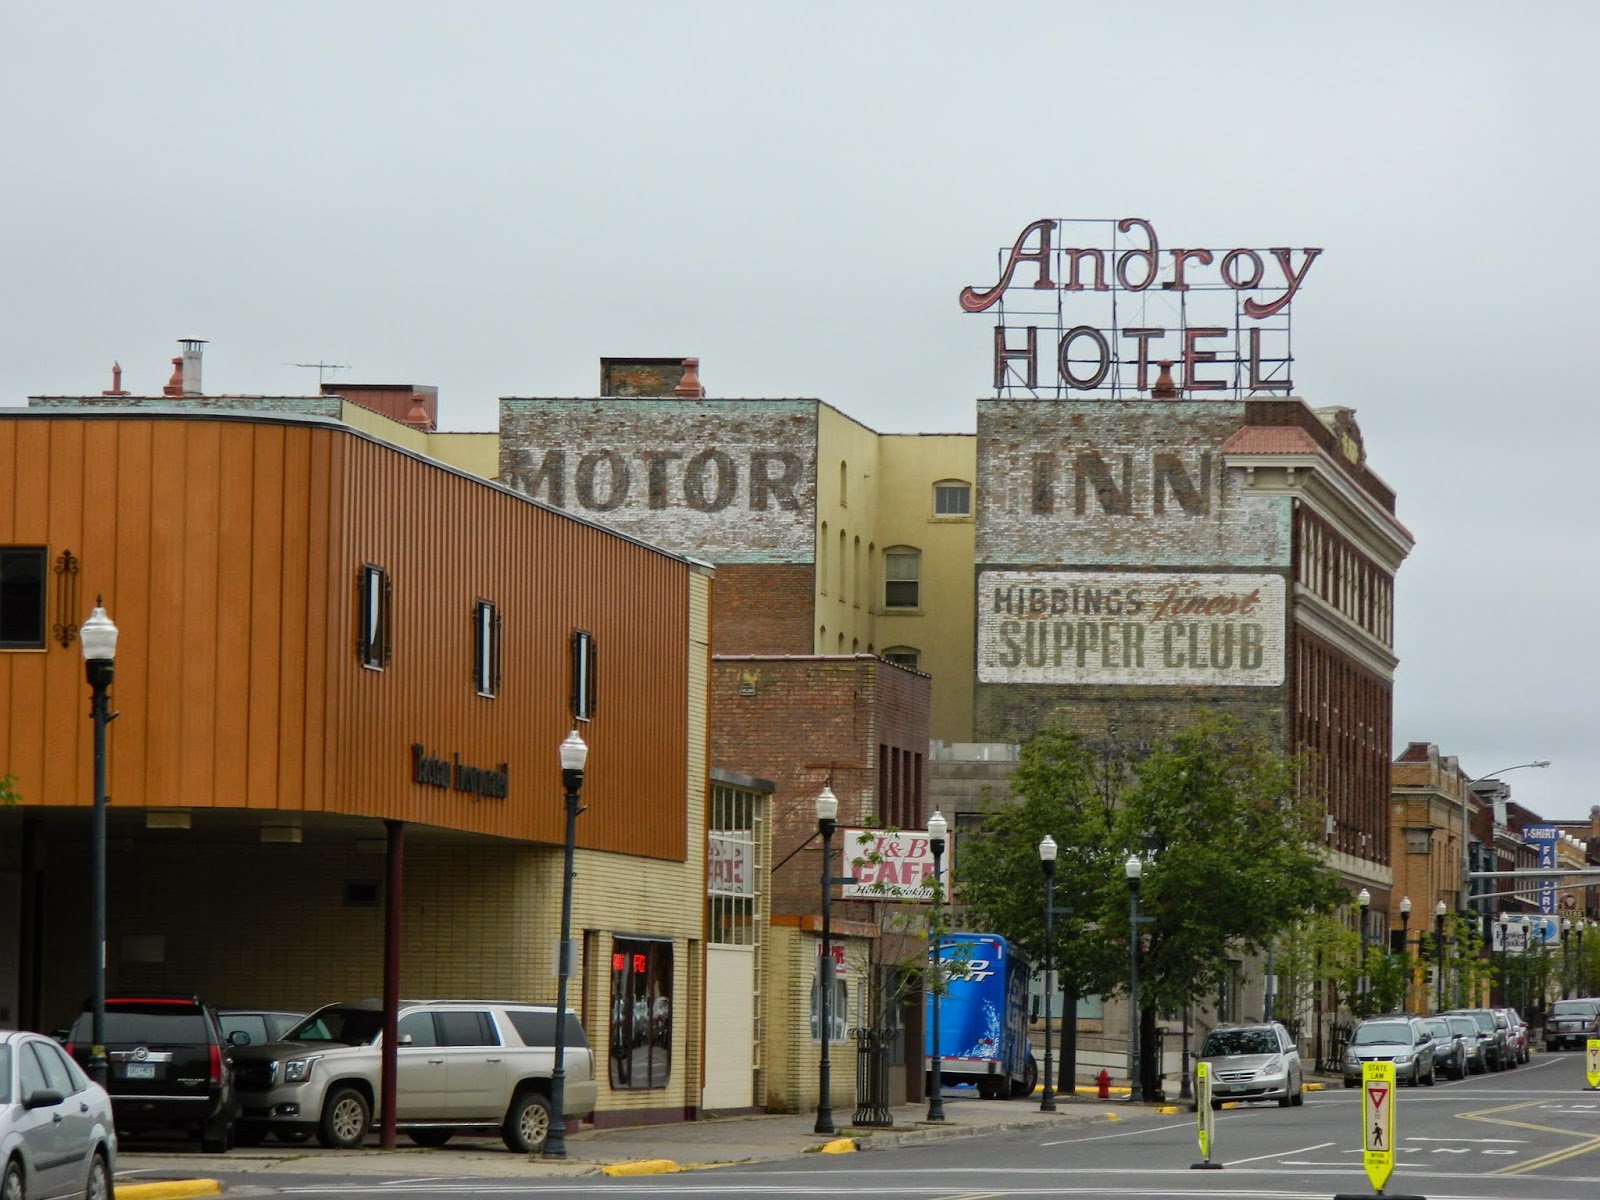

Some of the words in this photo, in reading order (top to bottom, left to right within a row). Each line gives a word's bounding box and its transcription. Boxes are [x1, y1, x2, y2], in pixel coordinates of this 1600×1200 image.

[959, 218, 1323, 318] Androy
[993, 325, 1293, 390] HOTEL
[506, 449, 803, 512] MOTOR
[1031, 452, 1212, 517] INN
[994, 587, 1143, 616] HIBBINGS
[1000, 621, 1145, 669] SUPPER
[1163, 622, 1263, 670] CLUB
[1522, 828, 1556, 839] T-SHIRT
[854, 885, 890, 896] Hom
[1542, 846, 1551, 914] FAORY
[1496, 930, 1525, 939] Fower
[1368, 1064, 1388, 1072] STATE
